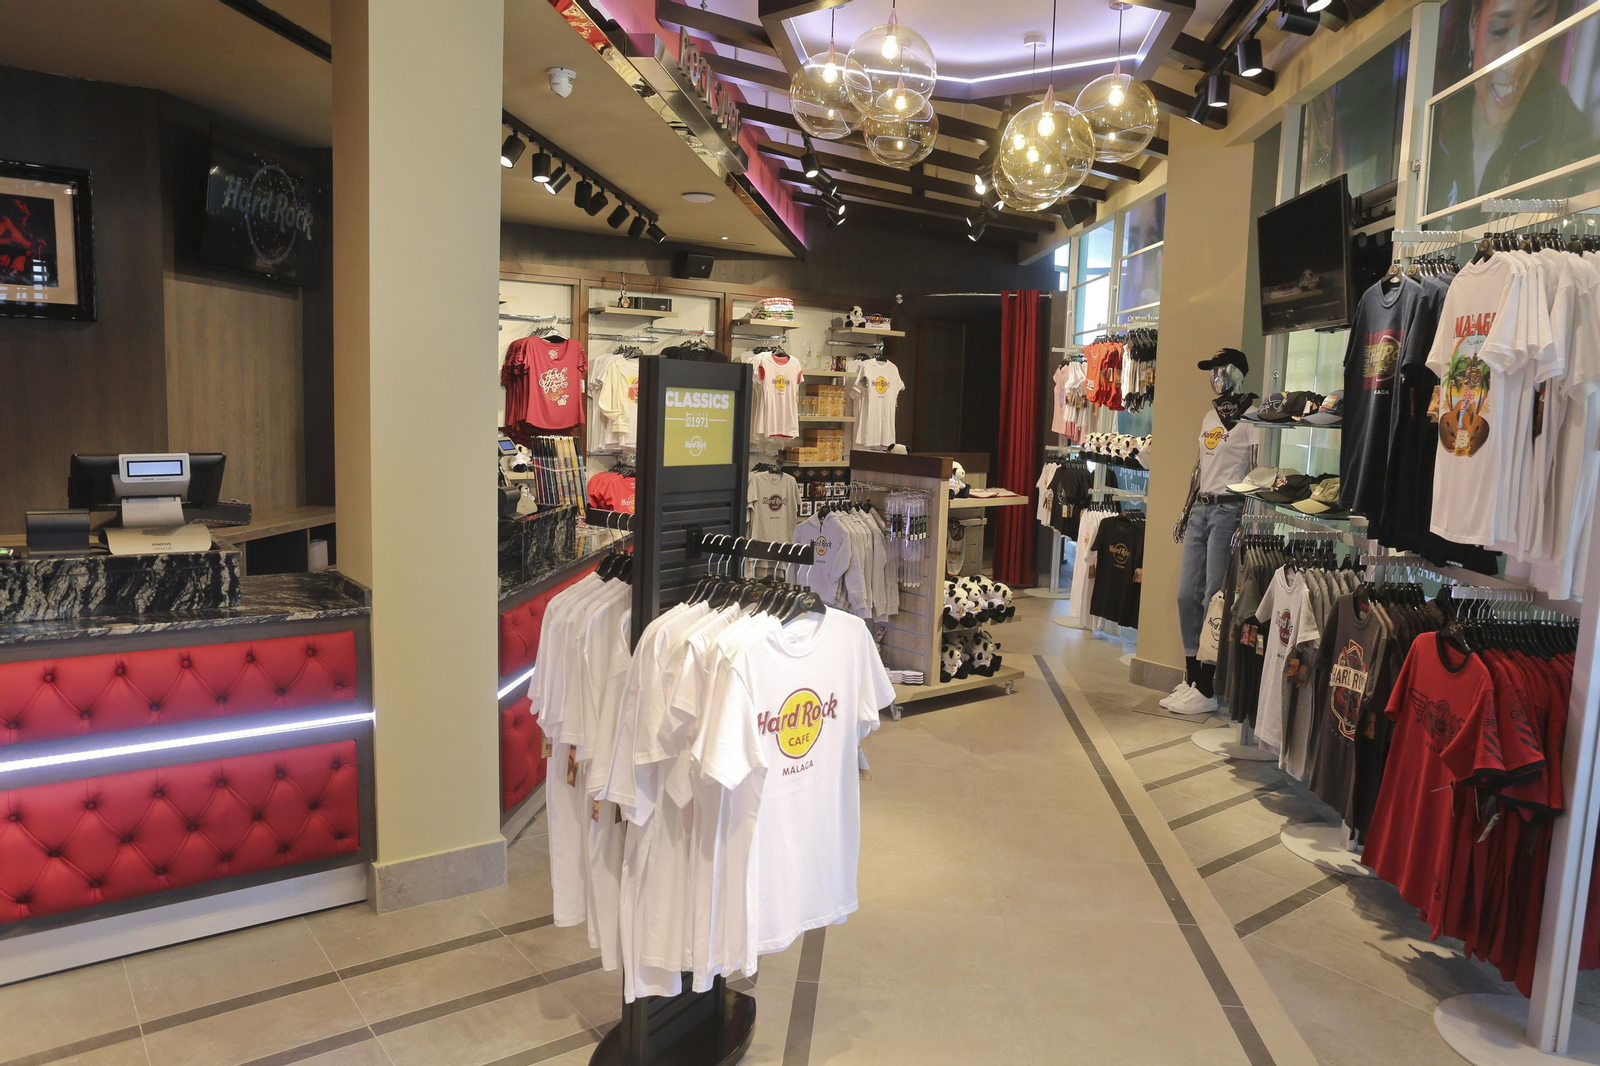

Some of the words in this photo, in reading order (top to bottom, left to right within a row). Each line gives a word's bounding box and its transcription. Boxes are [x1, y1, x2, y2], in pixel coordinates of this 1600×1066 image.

[221, 174, 274, 221] Hard
[273, 193, 314, 240] Rock
[665, 390, 730, 410] CLASSICS
[691, 416, 709, 428] 1971
[1201, 430, 1217, 439] Hard
[1215, 430, 1230, 443] Rock
[684, 441, 696, 449] Hard
[695, 441, 707, 450] Rock
[621, 498, 635, 506] Hard
[762, 496, 776, 505] Hard
[775, 497, 788, 506] Rock
[810, 538, 821, 547] ard
[820, 539, 832, 549] Rock
[1120, 547, 1130, 558] Roc
[757, 703, 801, 735] Hard
[801, 692, 838, 728] Rock
[788, 733, 810, 747] CAFE
[782, 759, 814, 777] MALAGA
